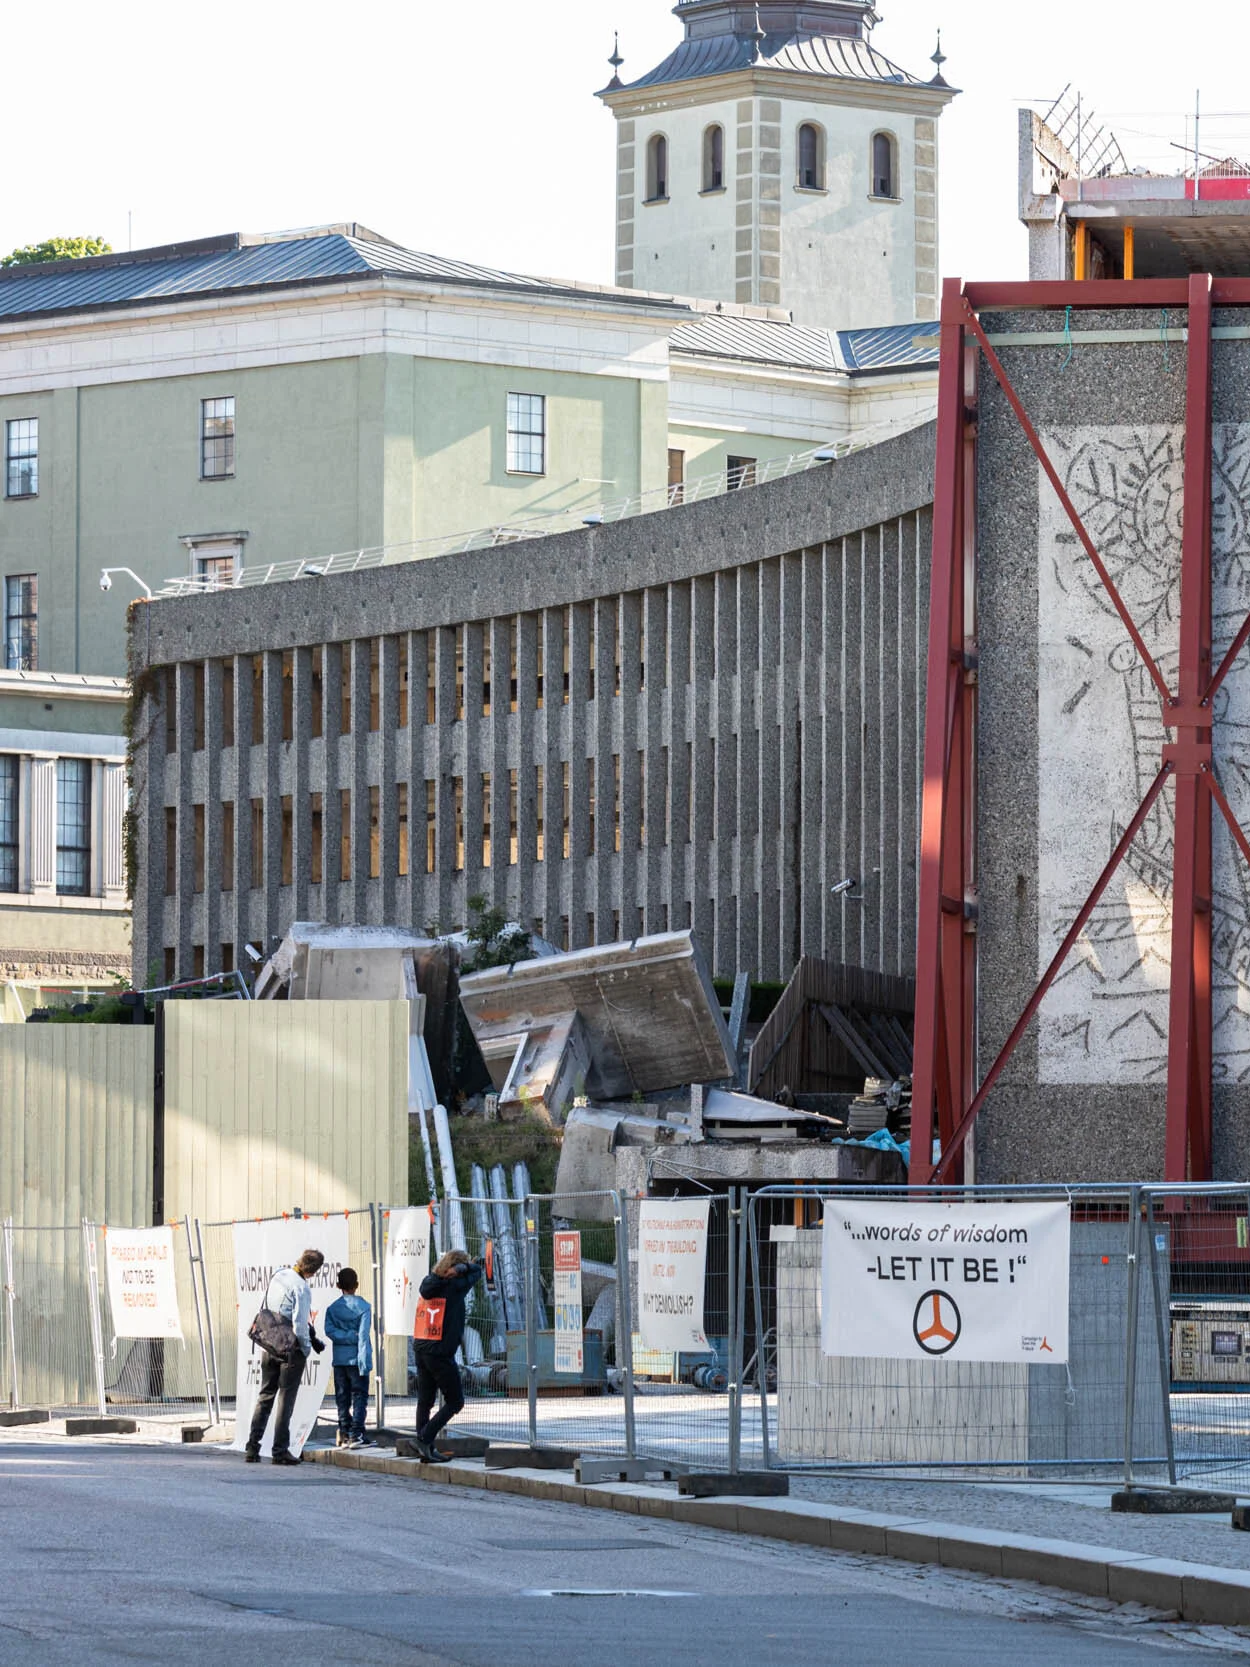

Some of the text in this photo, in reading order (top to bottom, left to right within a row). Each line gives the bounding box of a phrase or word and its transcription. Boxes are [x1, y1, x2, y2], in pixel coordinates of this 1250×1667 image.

[927, 1224, 950, 1242] of
[953, 1223, 1028, 1244] wisdom
[144, 1269, 155, 1284] BE
[930, 1257, 954, 1282] IT
[963, 1258, 999, 1283] BE
[655, 1294, 694, 1315] DEMOLISH?
